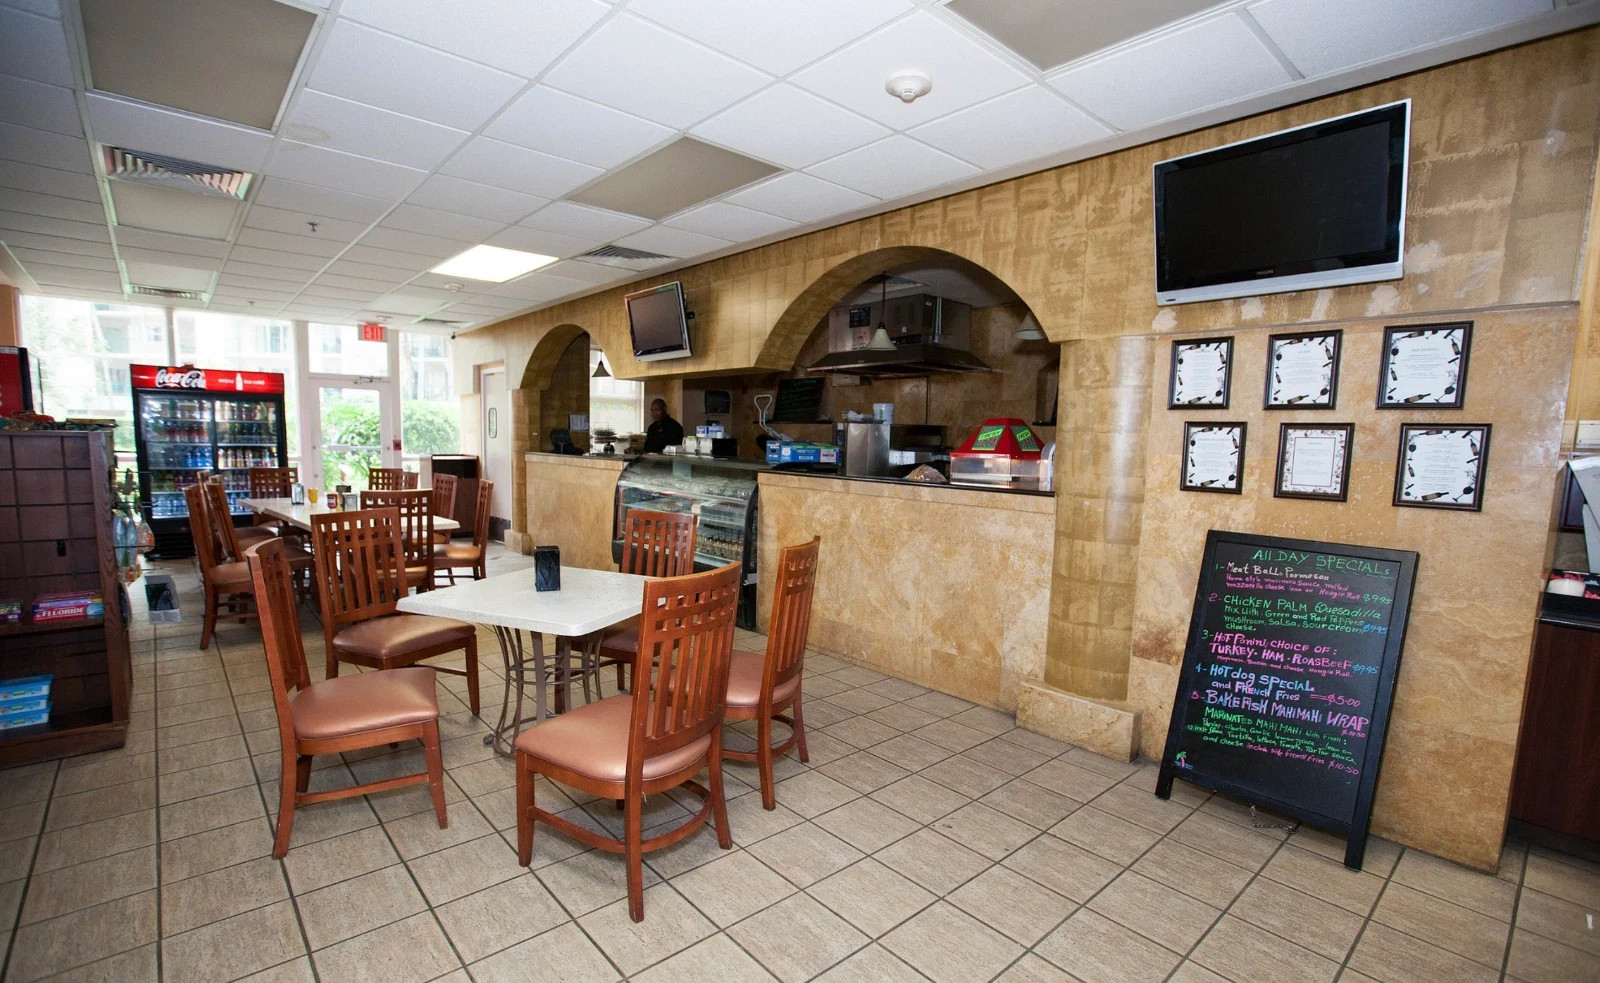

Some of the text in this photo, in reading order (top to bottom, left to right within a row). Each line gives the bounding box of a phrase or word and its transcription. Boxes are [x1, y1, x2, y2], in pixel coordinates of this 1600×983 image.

[1275, 551, 1310, 565] DAY
[1226, 562, 1249, 575] Meat
[1261, 649, 1285, 662] HAM
[1231, 667, 1256, 688] dog
[1211, 681, 1231, 690] and
[1275, 690, 1301, 701] Fries
[1326, 711, 1370, 731] WRAP
